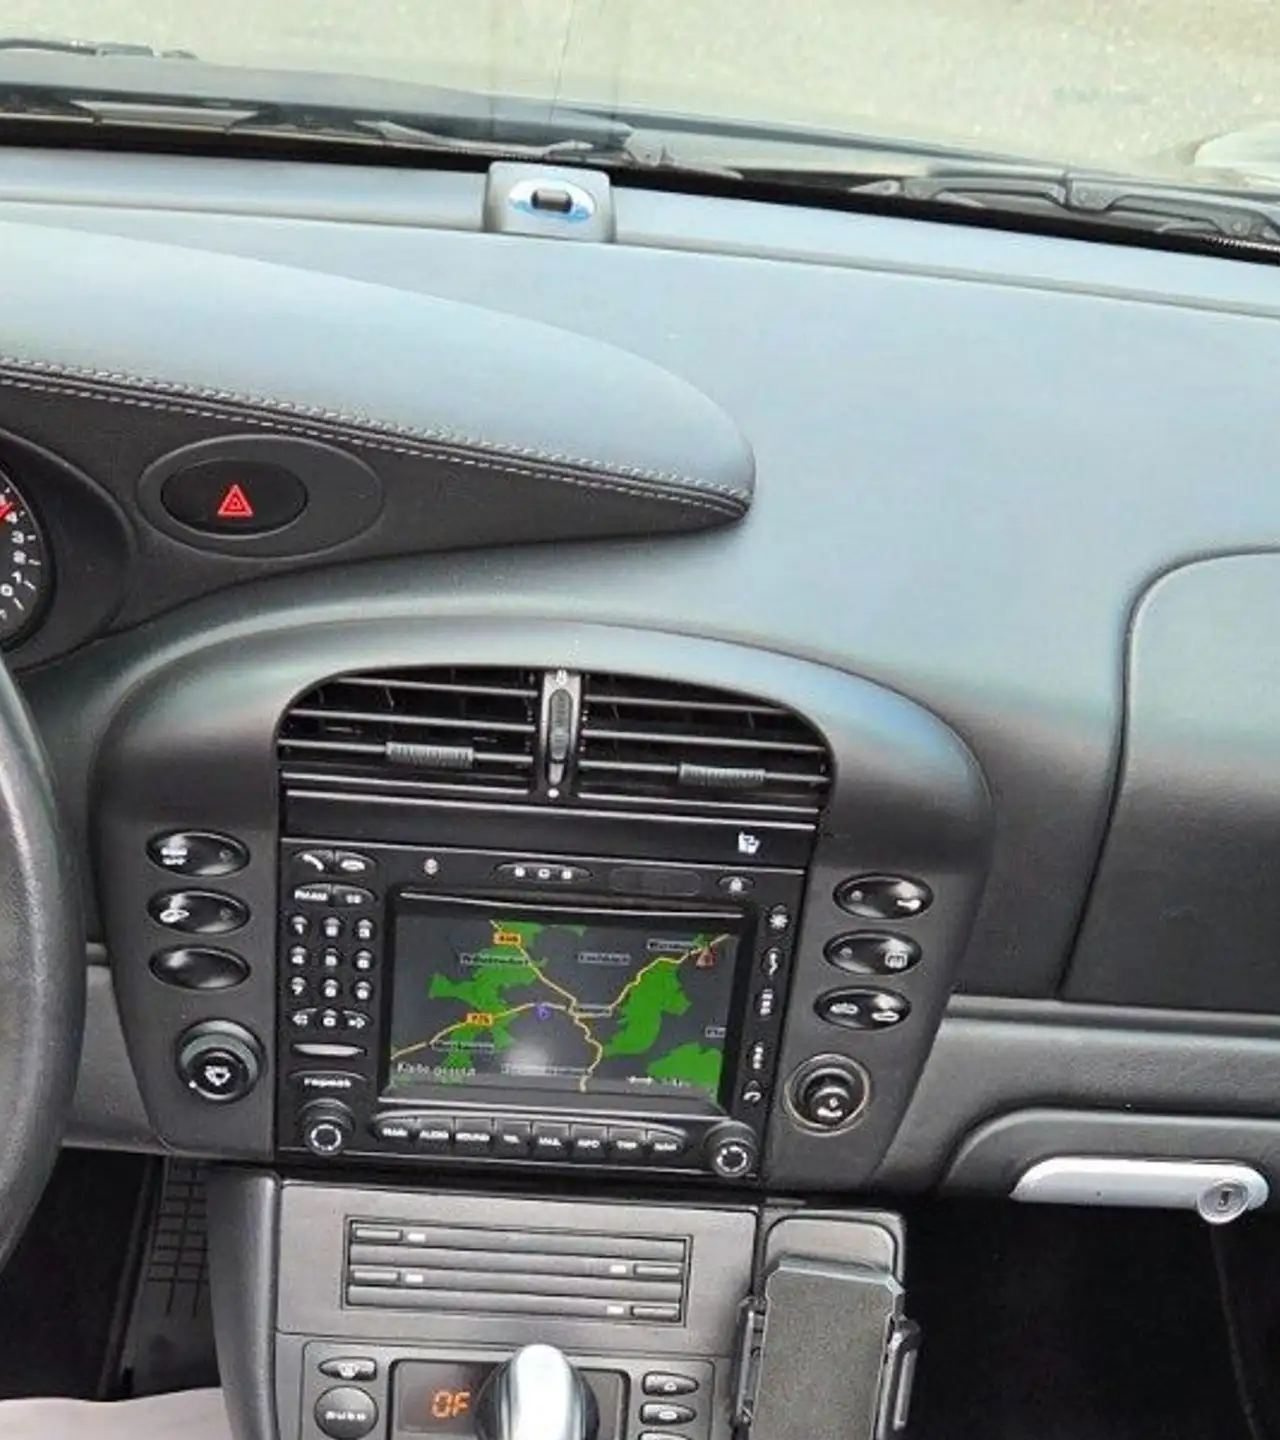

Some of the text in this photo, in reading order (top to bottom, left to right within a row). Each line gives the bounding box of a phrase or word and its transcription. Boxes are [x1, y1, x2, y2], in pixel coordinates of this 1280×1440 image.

[10, 530, 25, 545] 3
[11, 570, 23, 585] 1
[0, 583, 14, 597] 0
